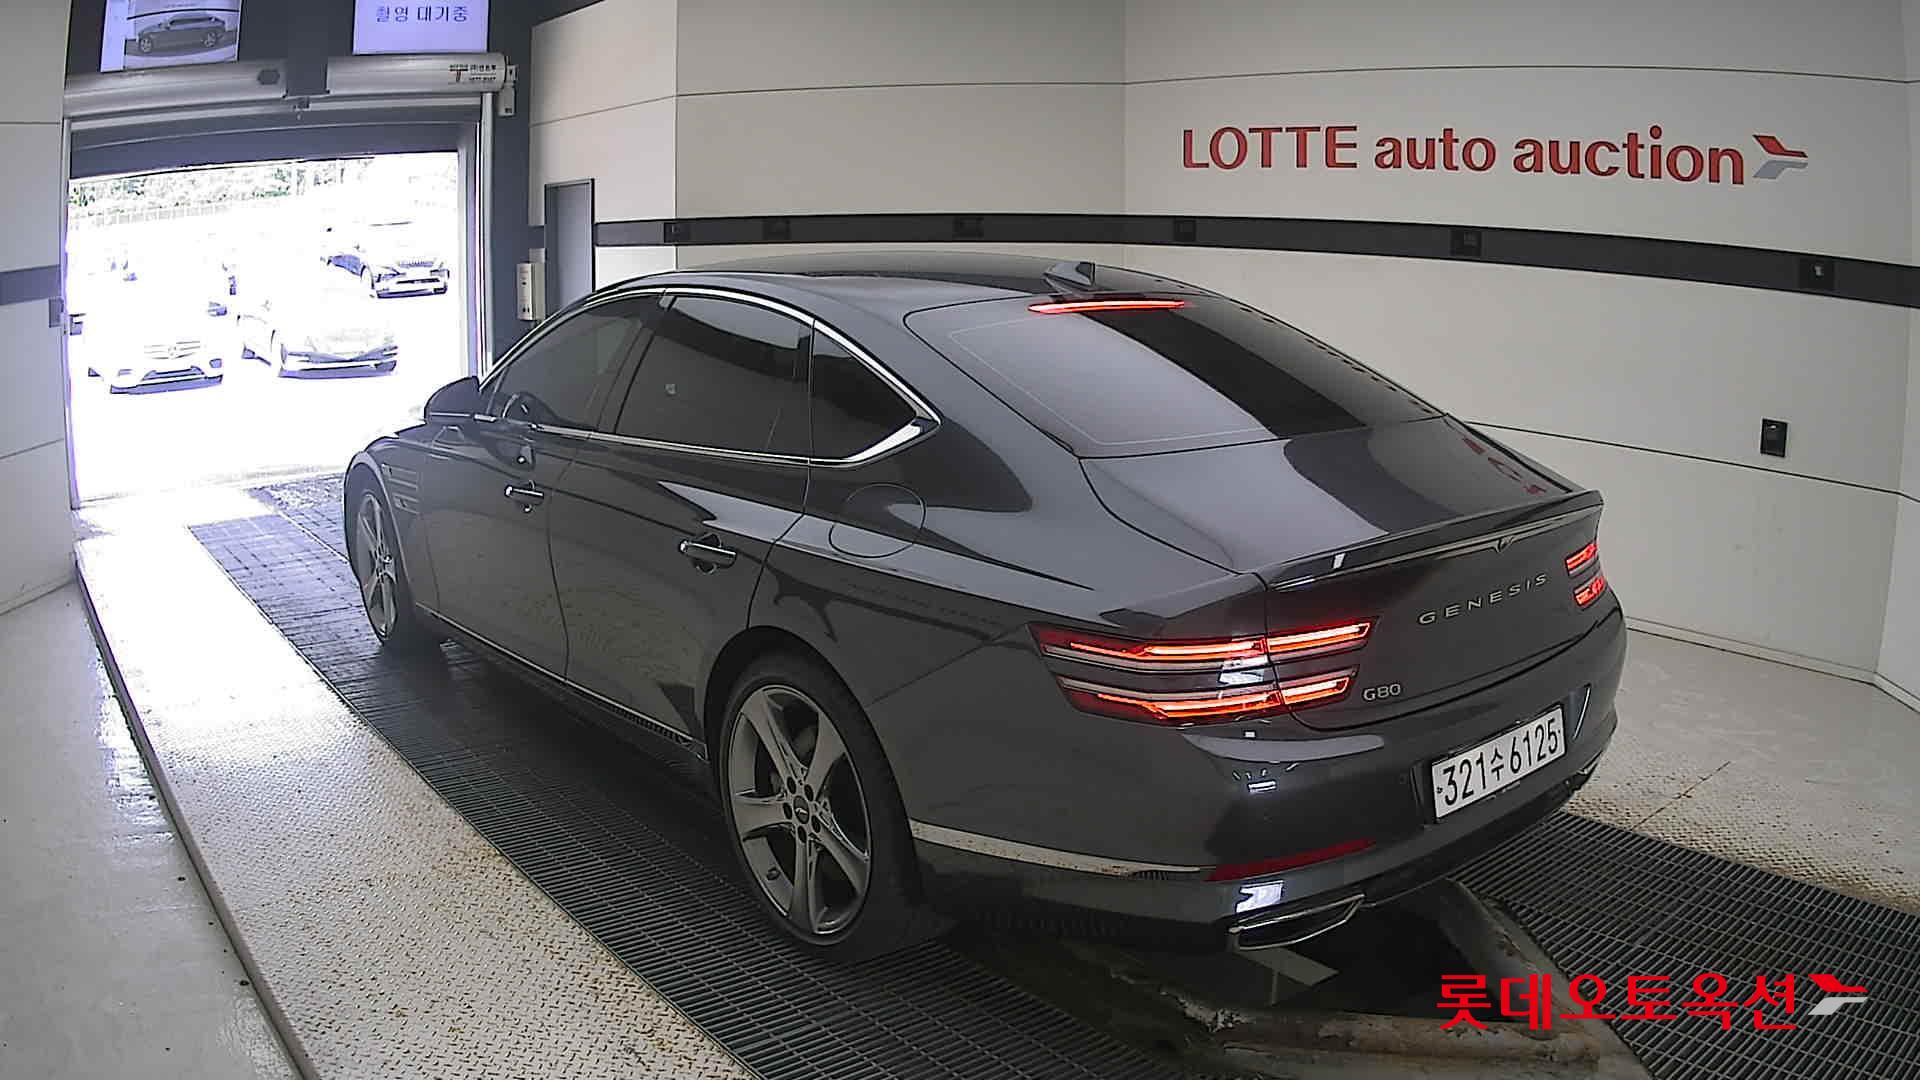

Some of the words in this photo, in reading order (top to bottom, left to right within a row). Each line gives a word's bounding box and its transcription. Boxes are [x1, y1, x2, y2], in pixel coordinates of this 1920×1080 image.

[417, 5, 468, 22] 대기중
[1183, 126, 1358, 169] LOTTE
[1374, 128, 1497, 172] auto
[1513, 125, 1744, 185] auction
[1418, 573, 1548, 624] GENESIS
[1363, 683, 1402, 701] G80
[1442, 718, 1560, 806] 321수6125
